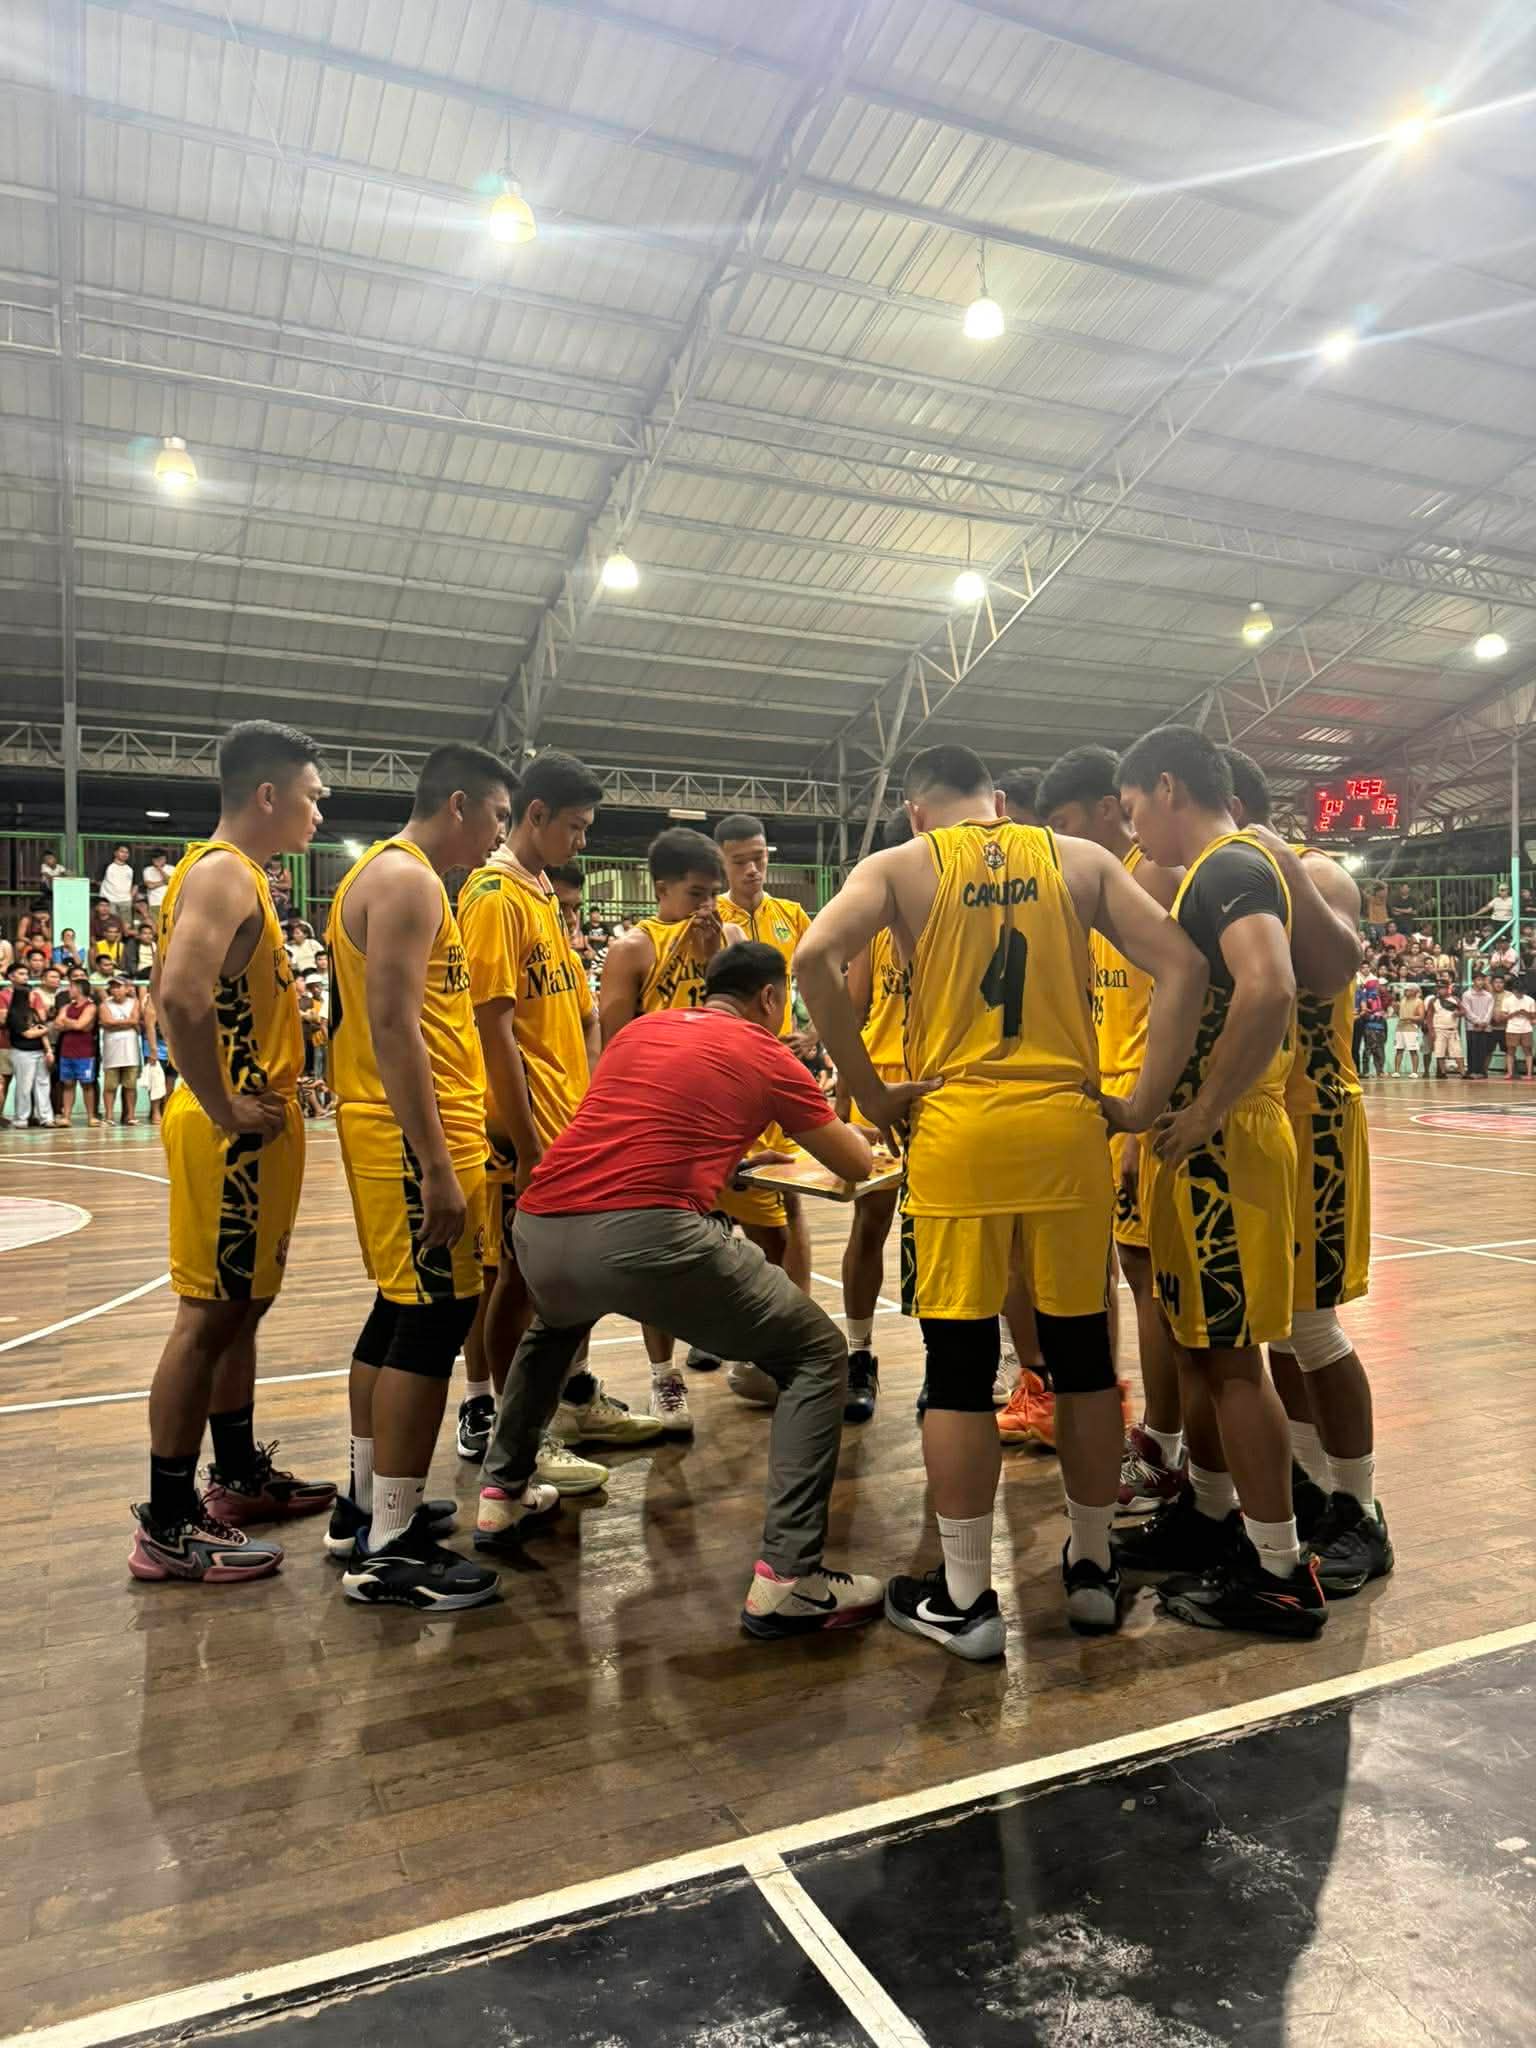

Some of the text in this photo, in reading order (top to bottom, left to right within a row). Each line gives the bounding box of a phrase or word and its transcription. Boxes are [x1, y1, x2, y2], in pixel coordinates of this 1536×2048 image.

[1346, 780, 1383, 797] 7:53
[1325, 800, 1344, 814] 04
[1319, 816, 1330, 829] 2
